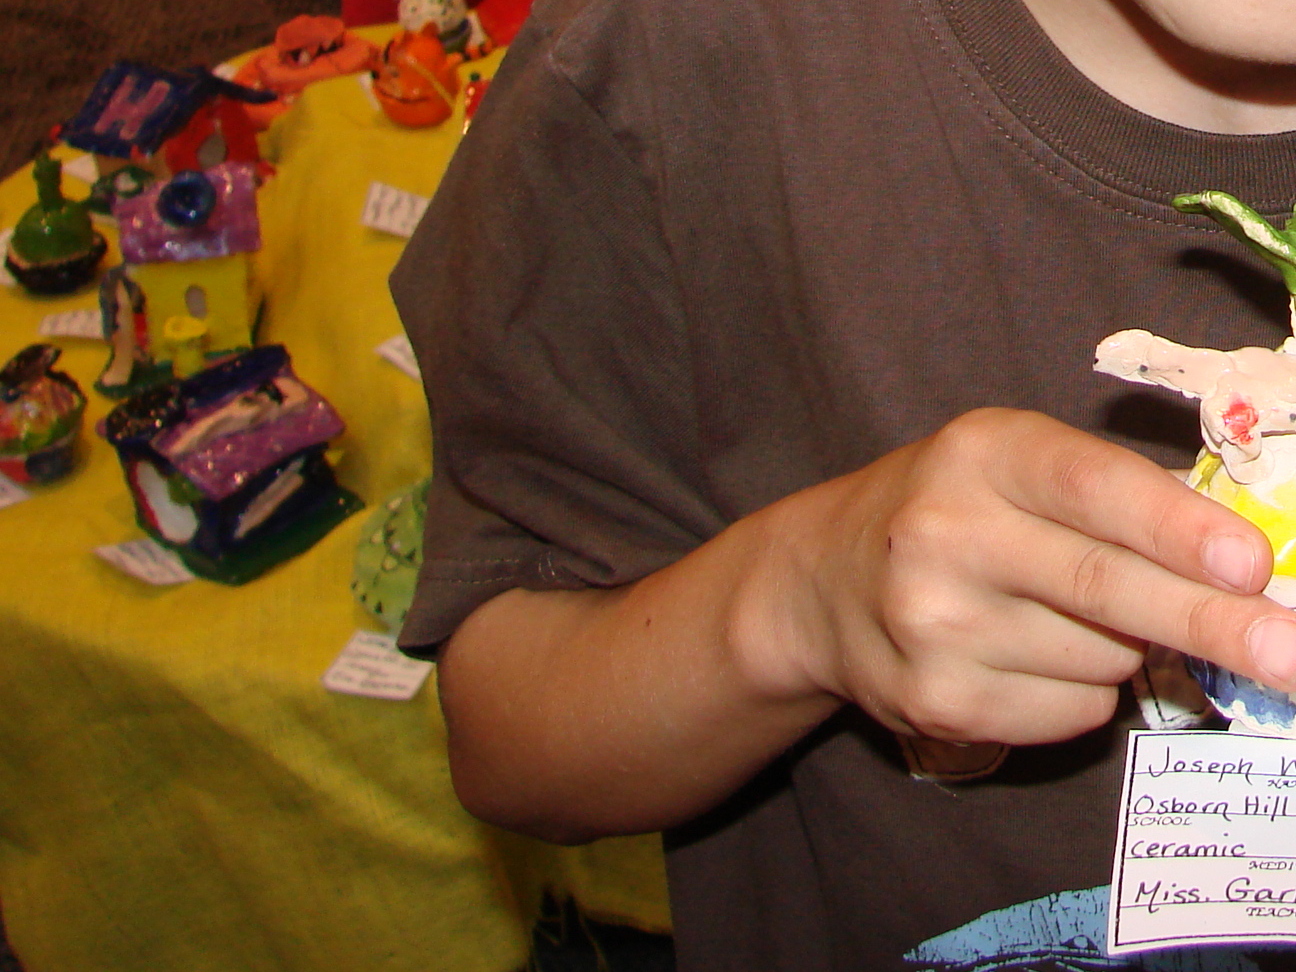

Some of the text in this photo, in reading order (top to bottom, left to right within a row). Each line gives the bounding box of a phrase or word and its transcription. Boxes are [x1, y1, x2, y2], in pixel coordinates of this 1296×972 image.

[1148, 746, 1254, 785] Joseph
[1134, 794, 1289, 821] Osborn Hill
[1129, 816, 1193, 827] SCHOOL
